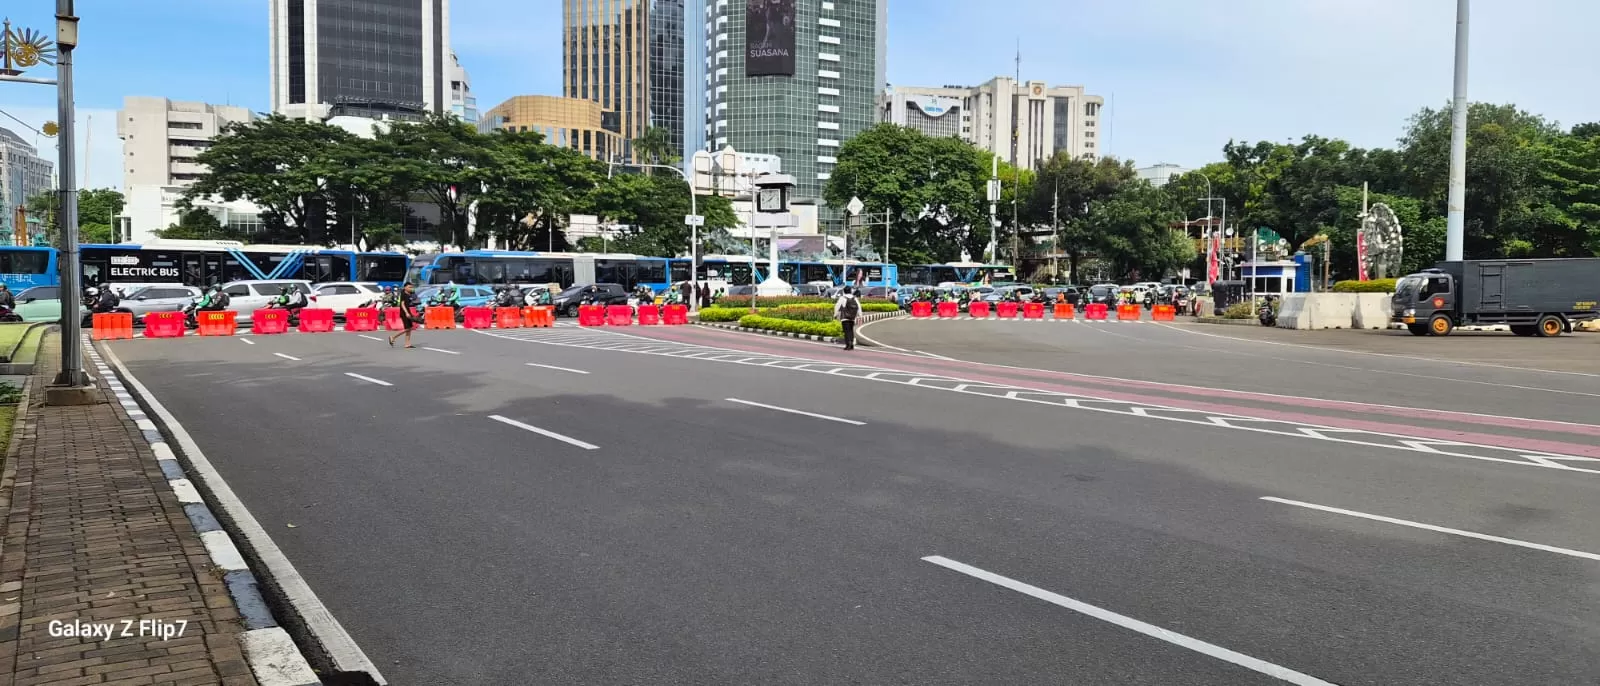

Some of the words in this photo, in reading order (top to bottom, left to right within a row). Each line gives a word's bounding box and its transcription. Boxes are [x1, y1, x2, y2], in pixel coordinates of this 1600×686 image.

[750, 48, 789, 58] SUASANA
[111, 267, 158, 276] ELECTRIC
[159, 268, 179, 276] BUS
